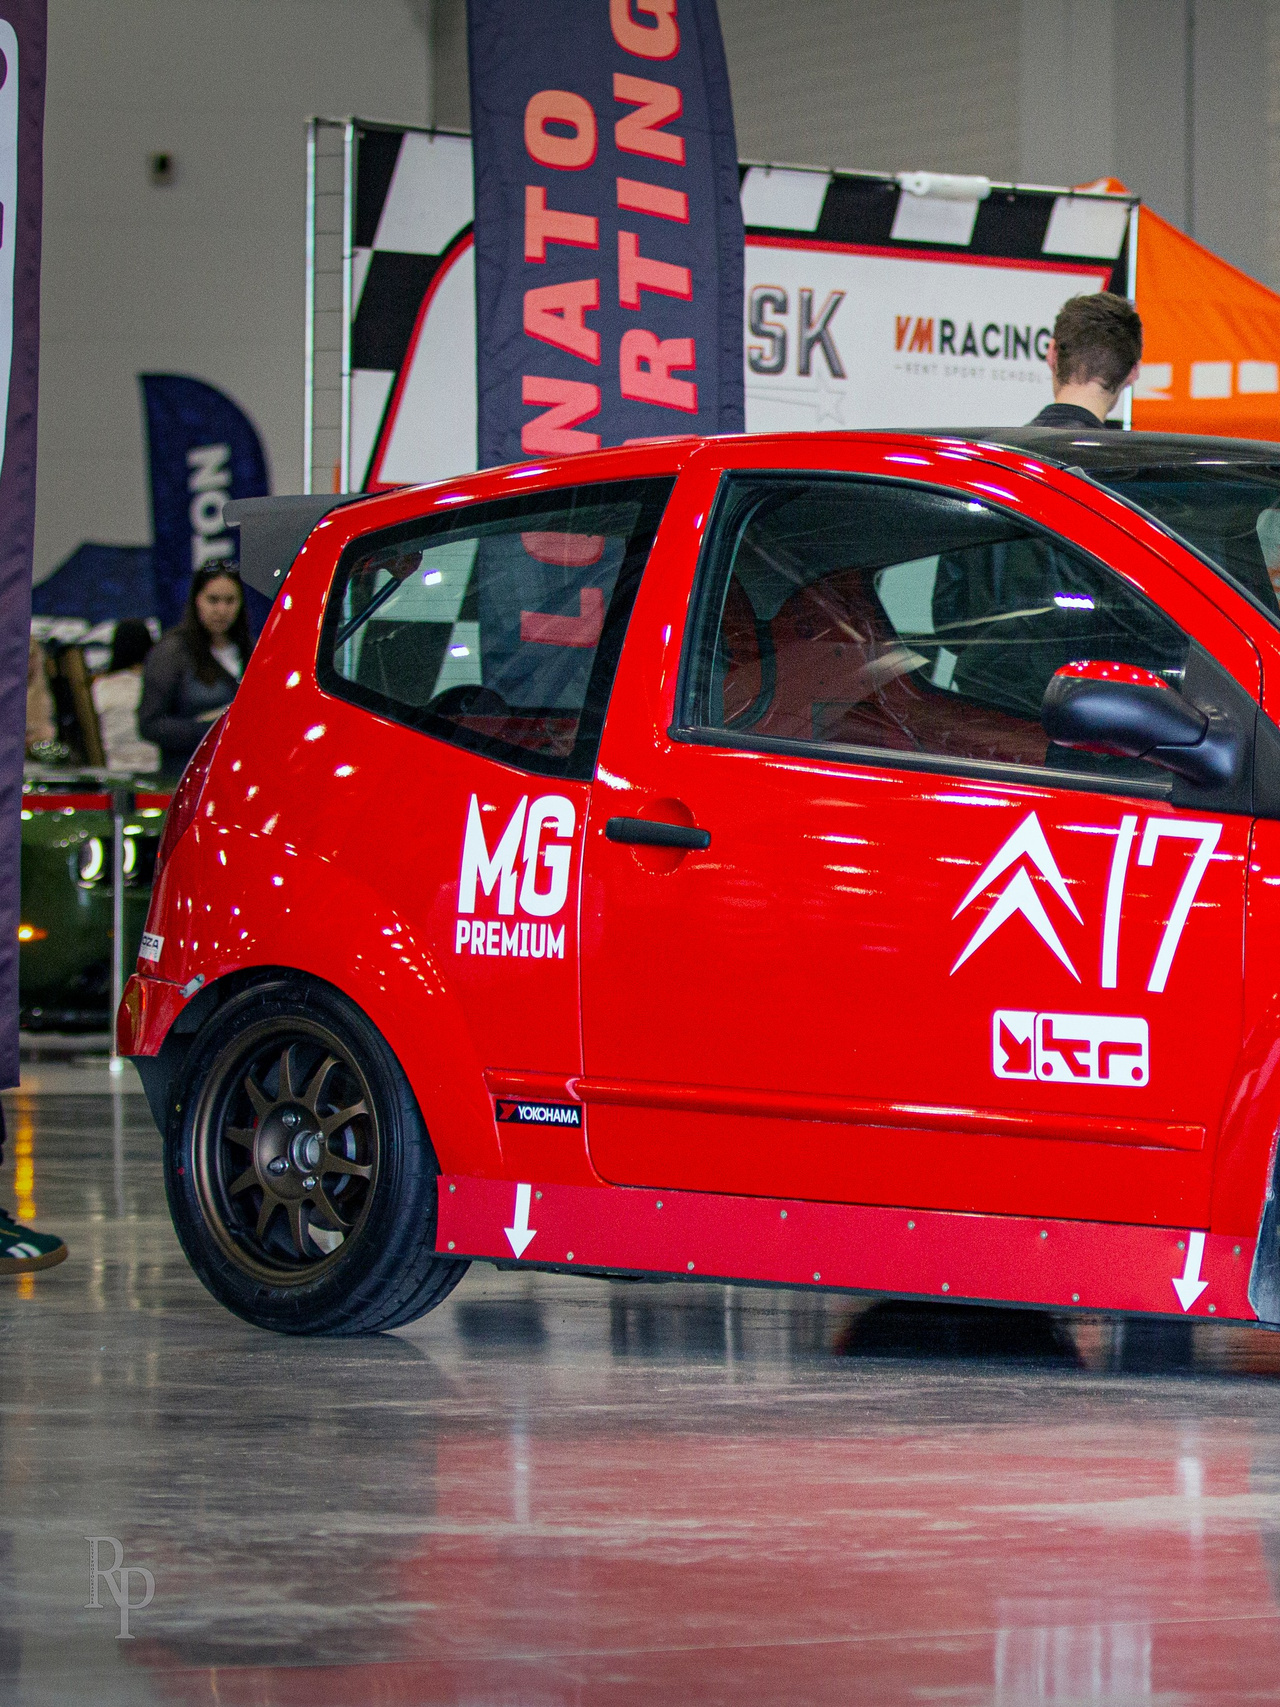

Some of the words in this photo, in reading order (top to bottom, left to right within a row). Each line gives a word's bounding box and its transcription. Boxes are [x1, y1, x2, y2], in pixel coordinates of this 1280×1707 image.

[609, 0, 698, 446] RTING
[944, 366, 985, 379] SPORT
[991, 369, 1042, 384] SCHOOL
[457, 793, 576, 917] MG
[455, 919, 565, 959] PREMIUM
[1101, 814, 1224, 993] 17
[518, 1105, 579, 1124] YOKOHAMA
